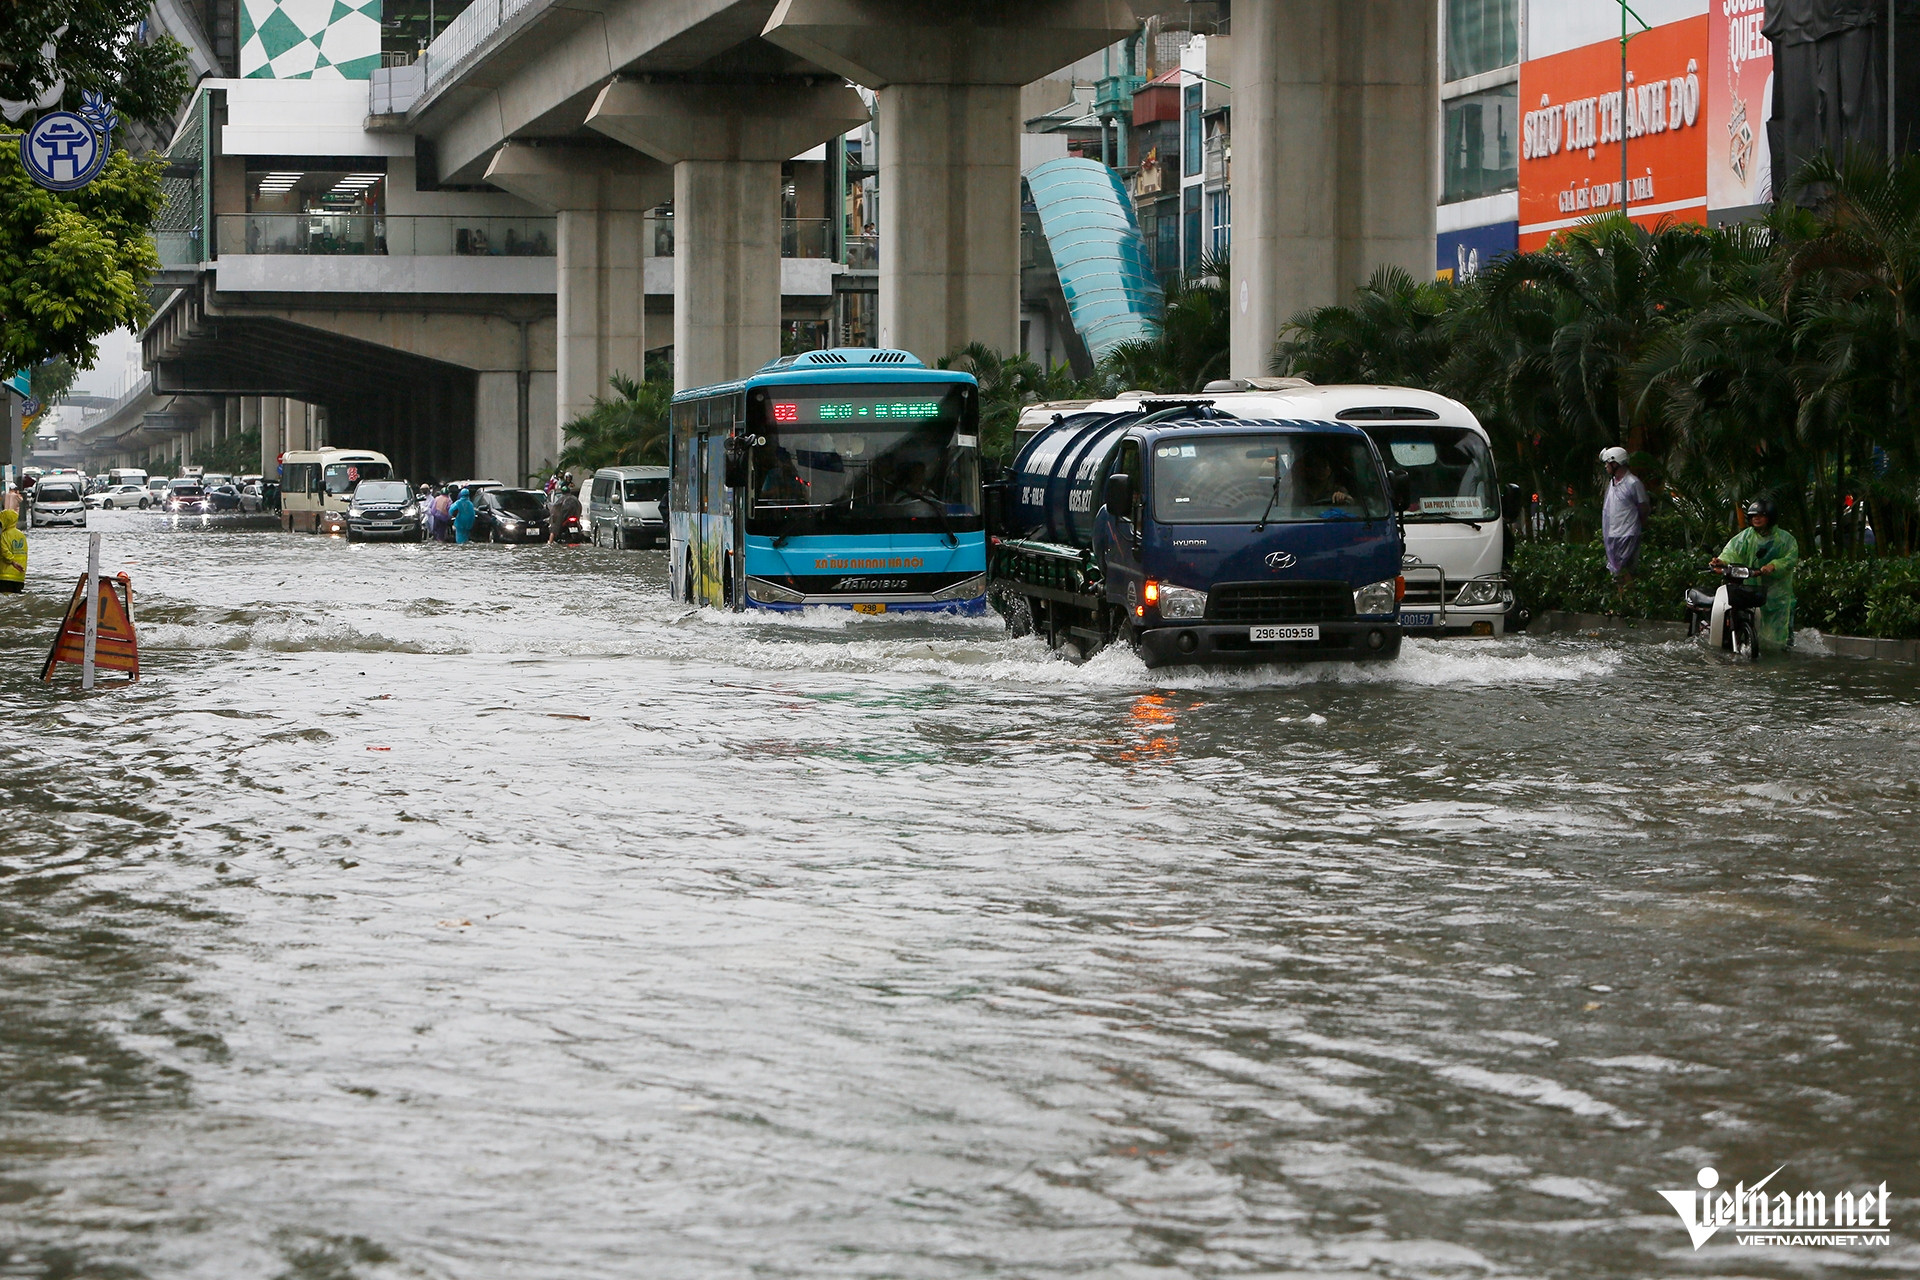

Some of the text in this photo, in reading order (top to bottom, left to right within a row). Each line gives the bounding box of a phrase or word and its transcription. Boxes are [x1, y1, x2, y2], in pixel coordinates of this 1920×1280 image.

[1524, 94, 1563, 160] SIÊU
[1565, 97, 1597, 160] THỊ
[1669, 58, 1699, 130] ĐÔ
[1559, 181, 1576, 213] GIÁ
[1591, 183, 1610, 208] CHO
[1633, 167, 1655, 201] NHÀ
[774, 403, 798, 421] 02
[829, 558, 849, 569] BUS
[850, 558, 886, 569] NHANH
[903, 556, 924, 570] NỘI
[831, 578, 908, 590] HANOIBUS
[1255, 628, 1314, 639] 29C-609.58
